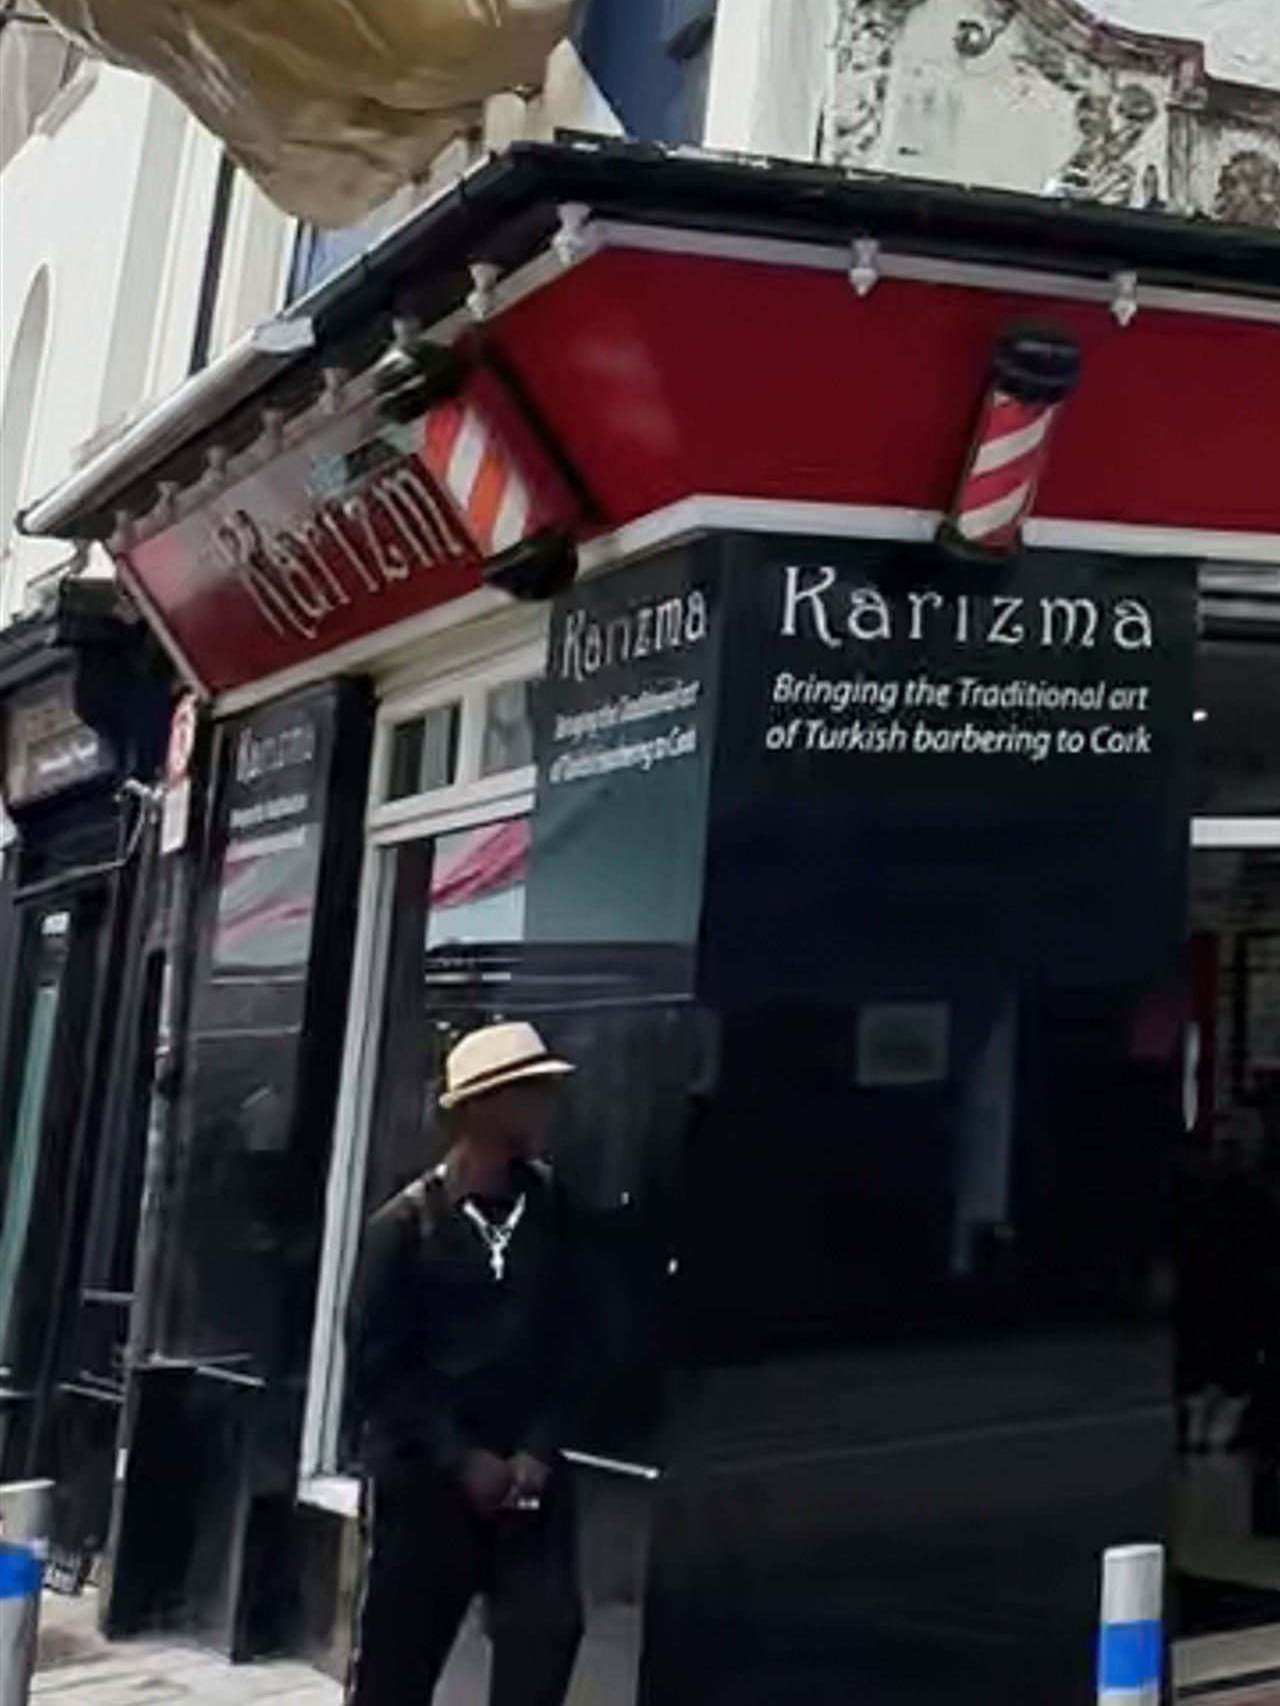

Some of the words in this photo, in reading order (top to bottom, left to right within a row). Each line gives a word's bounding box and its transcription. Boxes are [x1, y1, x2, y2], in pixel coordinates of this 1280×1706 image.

[209, 469, 467, 639] Karizm
[780, 566, 1153, 649] Karizma
[773, 672, 898, 713] Bringing
[904, 673, 949, 707] the
[958, 677, 1104, 709] Traditional
[1109, 685, 1149, 711] art
[766, 721, 799, 752] of
[804, 720, 907, 753] Turkish
[913, 724, 1051, 762] barbering
[1057, 729, 1084, 754] to
[1090, 725, 1152, 754] Cork
